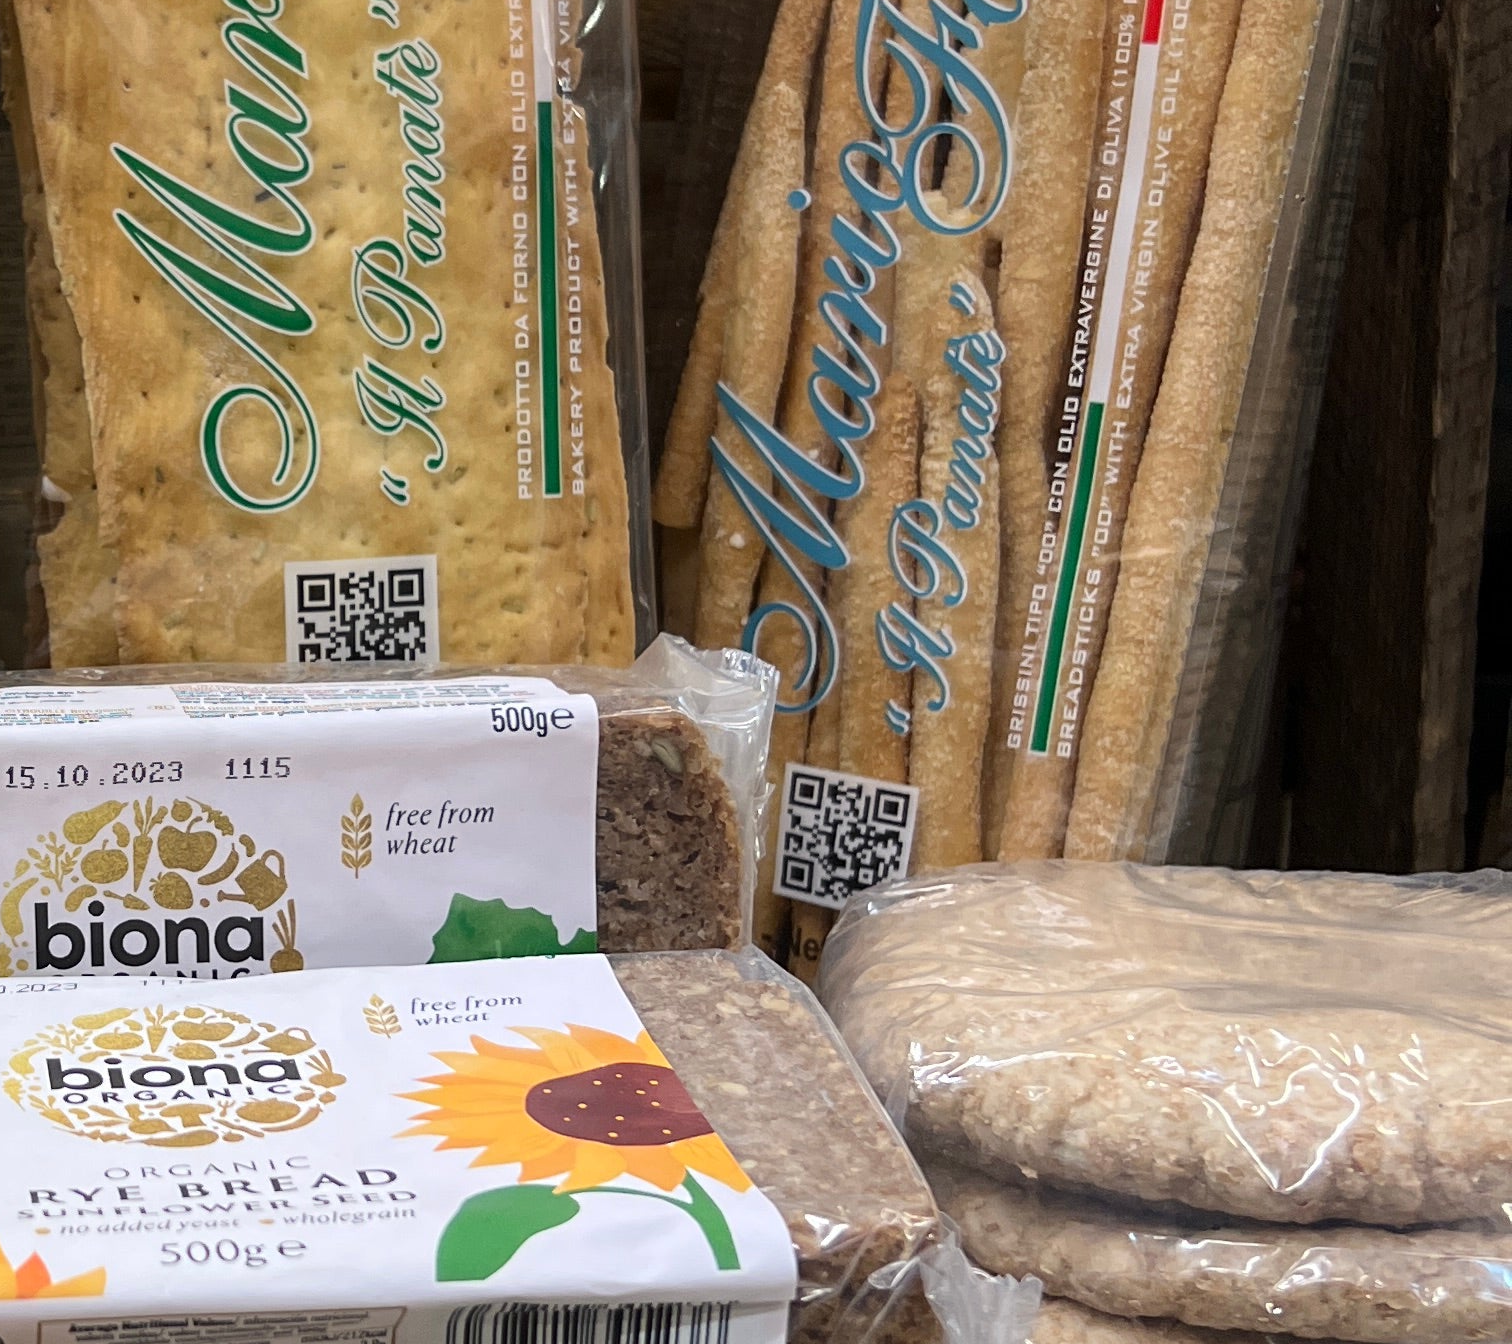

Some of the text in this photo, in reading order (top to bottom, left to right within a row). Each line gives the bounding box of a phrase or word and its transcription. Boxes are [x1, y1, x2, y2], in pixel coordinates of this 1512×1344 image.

[1111, 14, 1136, 88] (100%
[509, 71, 526, 133] OLIO
[556, 59, 577, 145] EXTRA
[1160, 68, 1181, 115] OIL
[1102, 96, 1125, 166] OLIVA
[511, 144, 528, 201] CON
[561, 157, 579, 228] WITH
[1096, 175, 1115, 200] DI
[1148, 127, 1173, 206] OLIVE
[511, 212, 530, 304] FORNO
[1129, 218, 1159, 315] VIRGIN
[566, 236, 584, 373] PRODUCT
[1067, 208, 1109, 388] EXTRAVERGINE
[513, 316, 530, 349] DA
[1116, 324, 1142, 411] EXTRA
[514, 359, 533, 500] PRODOTTO
[570, 384, 586, 496] BAKERY
[1057, 396, 1080, 453] OLIO
[1103, 420, 1128, 486] WITH
[1048, 460, 1070, 513] CON
[1024, 584, 1048, 637] TIPO
[1056, 568, 1103, 757] BREADSTICKS
[1007, 643, 1038, 750] GRISSINI
[5, 756, 292, 790] 15.10.2023 1115
[386, 799, 495, 831] free from
[387, 831, 458, 856] wheat
[33, 898, 266, 971] biona
[410, 992, 524, 1014] free from
[414, 1011, 490, 1029] wheat
[47, 1056, 303, 1093] biona
[63, 1082, 299, 1106] ORGANIC
[28, 1167, 402, 1205] RYE BREAD
[104, 1156, 311, 1181] ORGANIC
[17, 1189, 418, 1221] SUNFLOWER SEED
[60, 1216, 243, 1236] no added yeast
[283, 1207, 417, 1229] wholegrain
